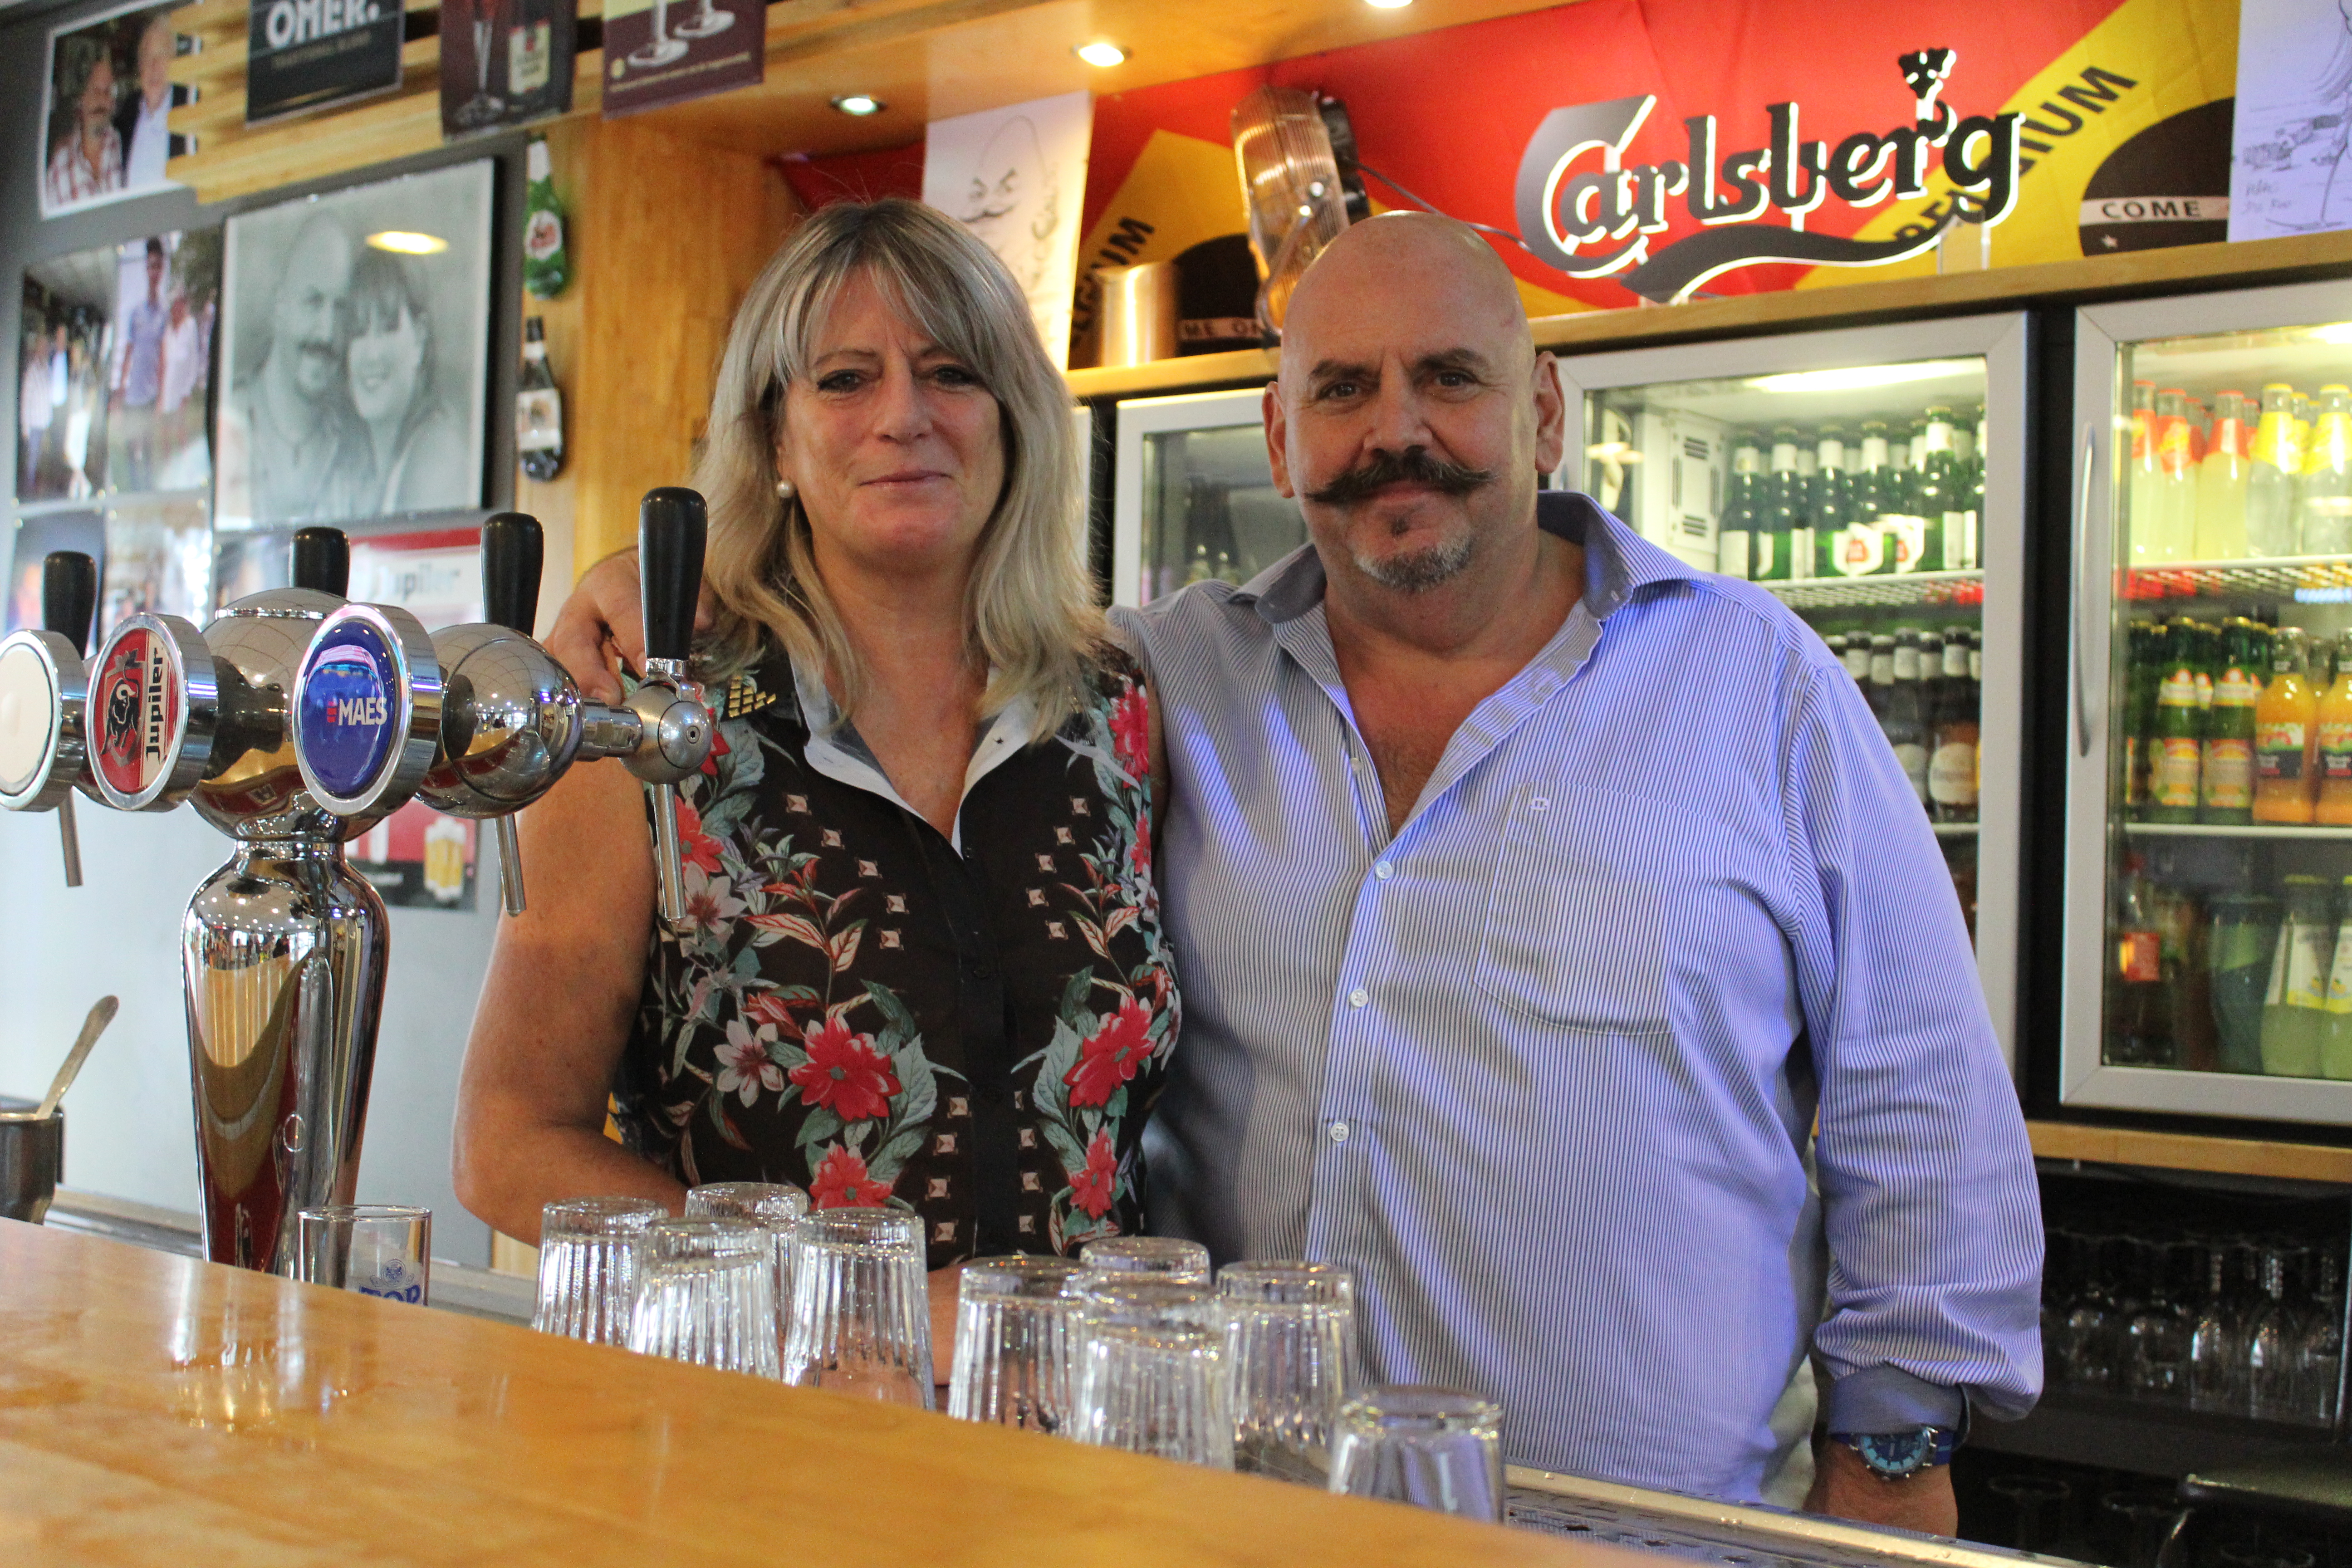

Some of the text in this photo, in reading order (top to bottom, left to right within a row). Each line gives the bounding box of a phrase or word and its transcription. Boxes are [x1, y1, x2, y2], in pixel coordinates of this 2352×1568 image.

[265, 0, 380, 49] OMER.
[1514, 88, 2026, 278] Carlsberg
[2102, 200, 2201, 219] COME
[146, 645, 165, 765] Jupiler
[338, 697, 388, 726] MAES
